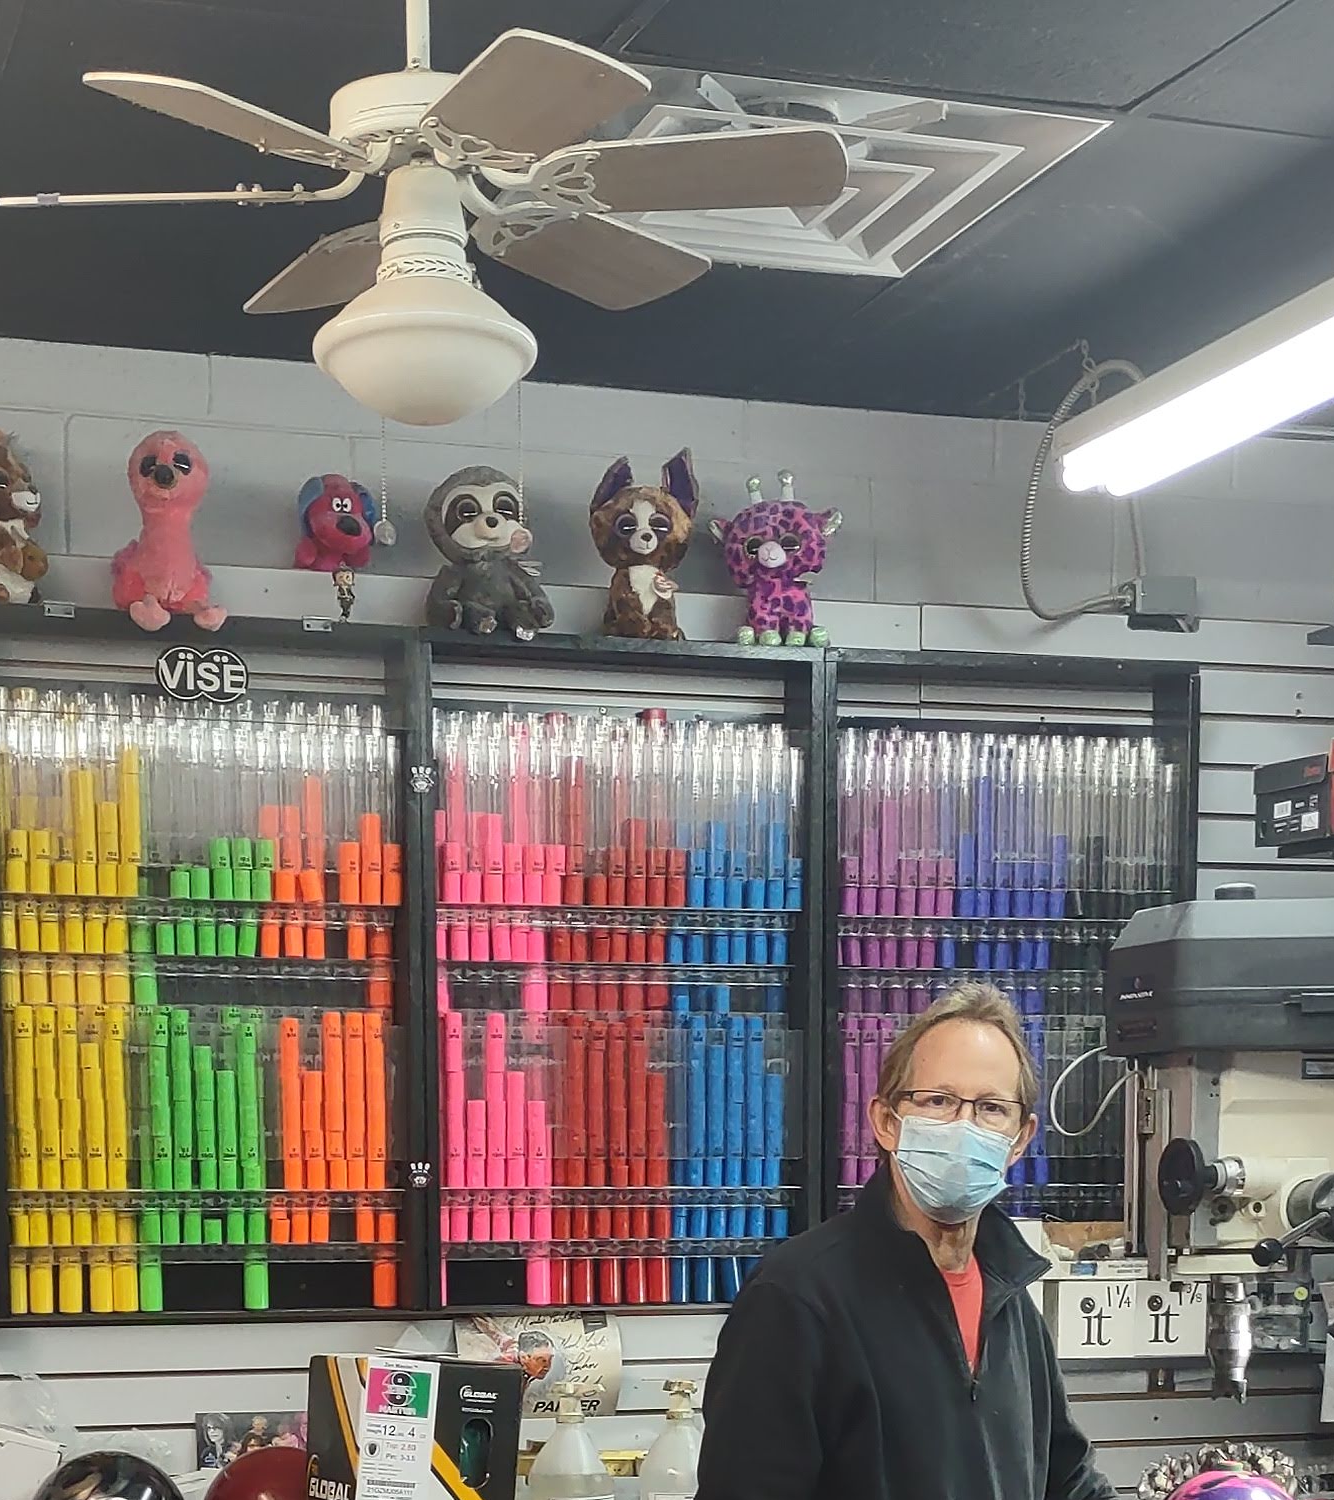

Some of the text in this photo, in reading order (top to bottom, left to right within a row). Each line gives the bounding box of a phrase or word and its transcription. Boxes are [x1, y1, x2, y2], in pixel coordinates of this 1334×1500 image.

[533, 1399, 602, 1414] PAER
[382, 1425, 416, 1437] 12 4
